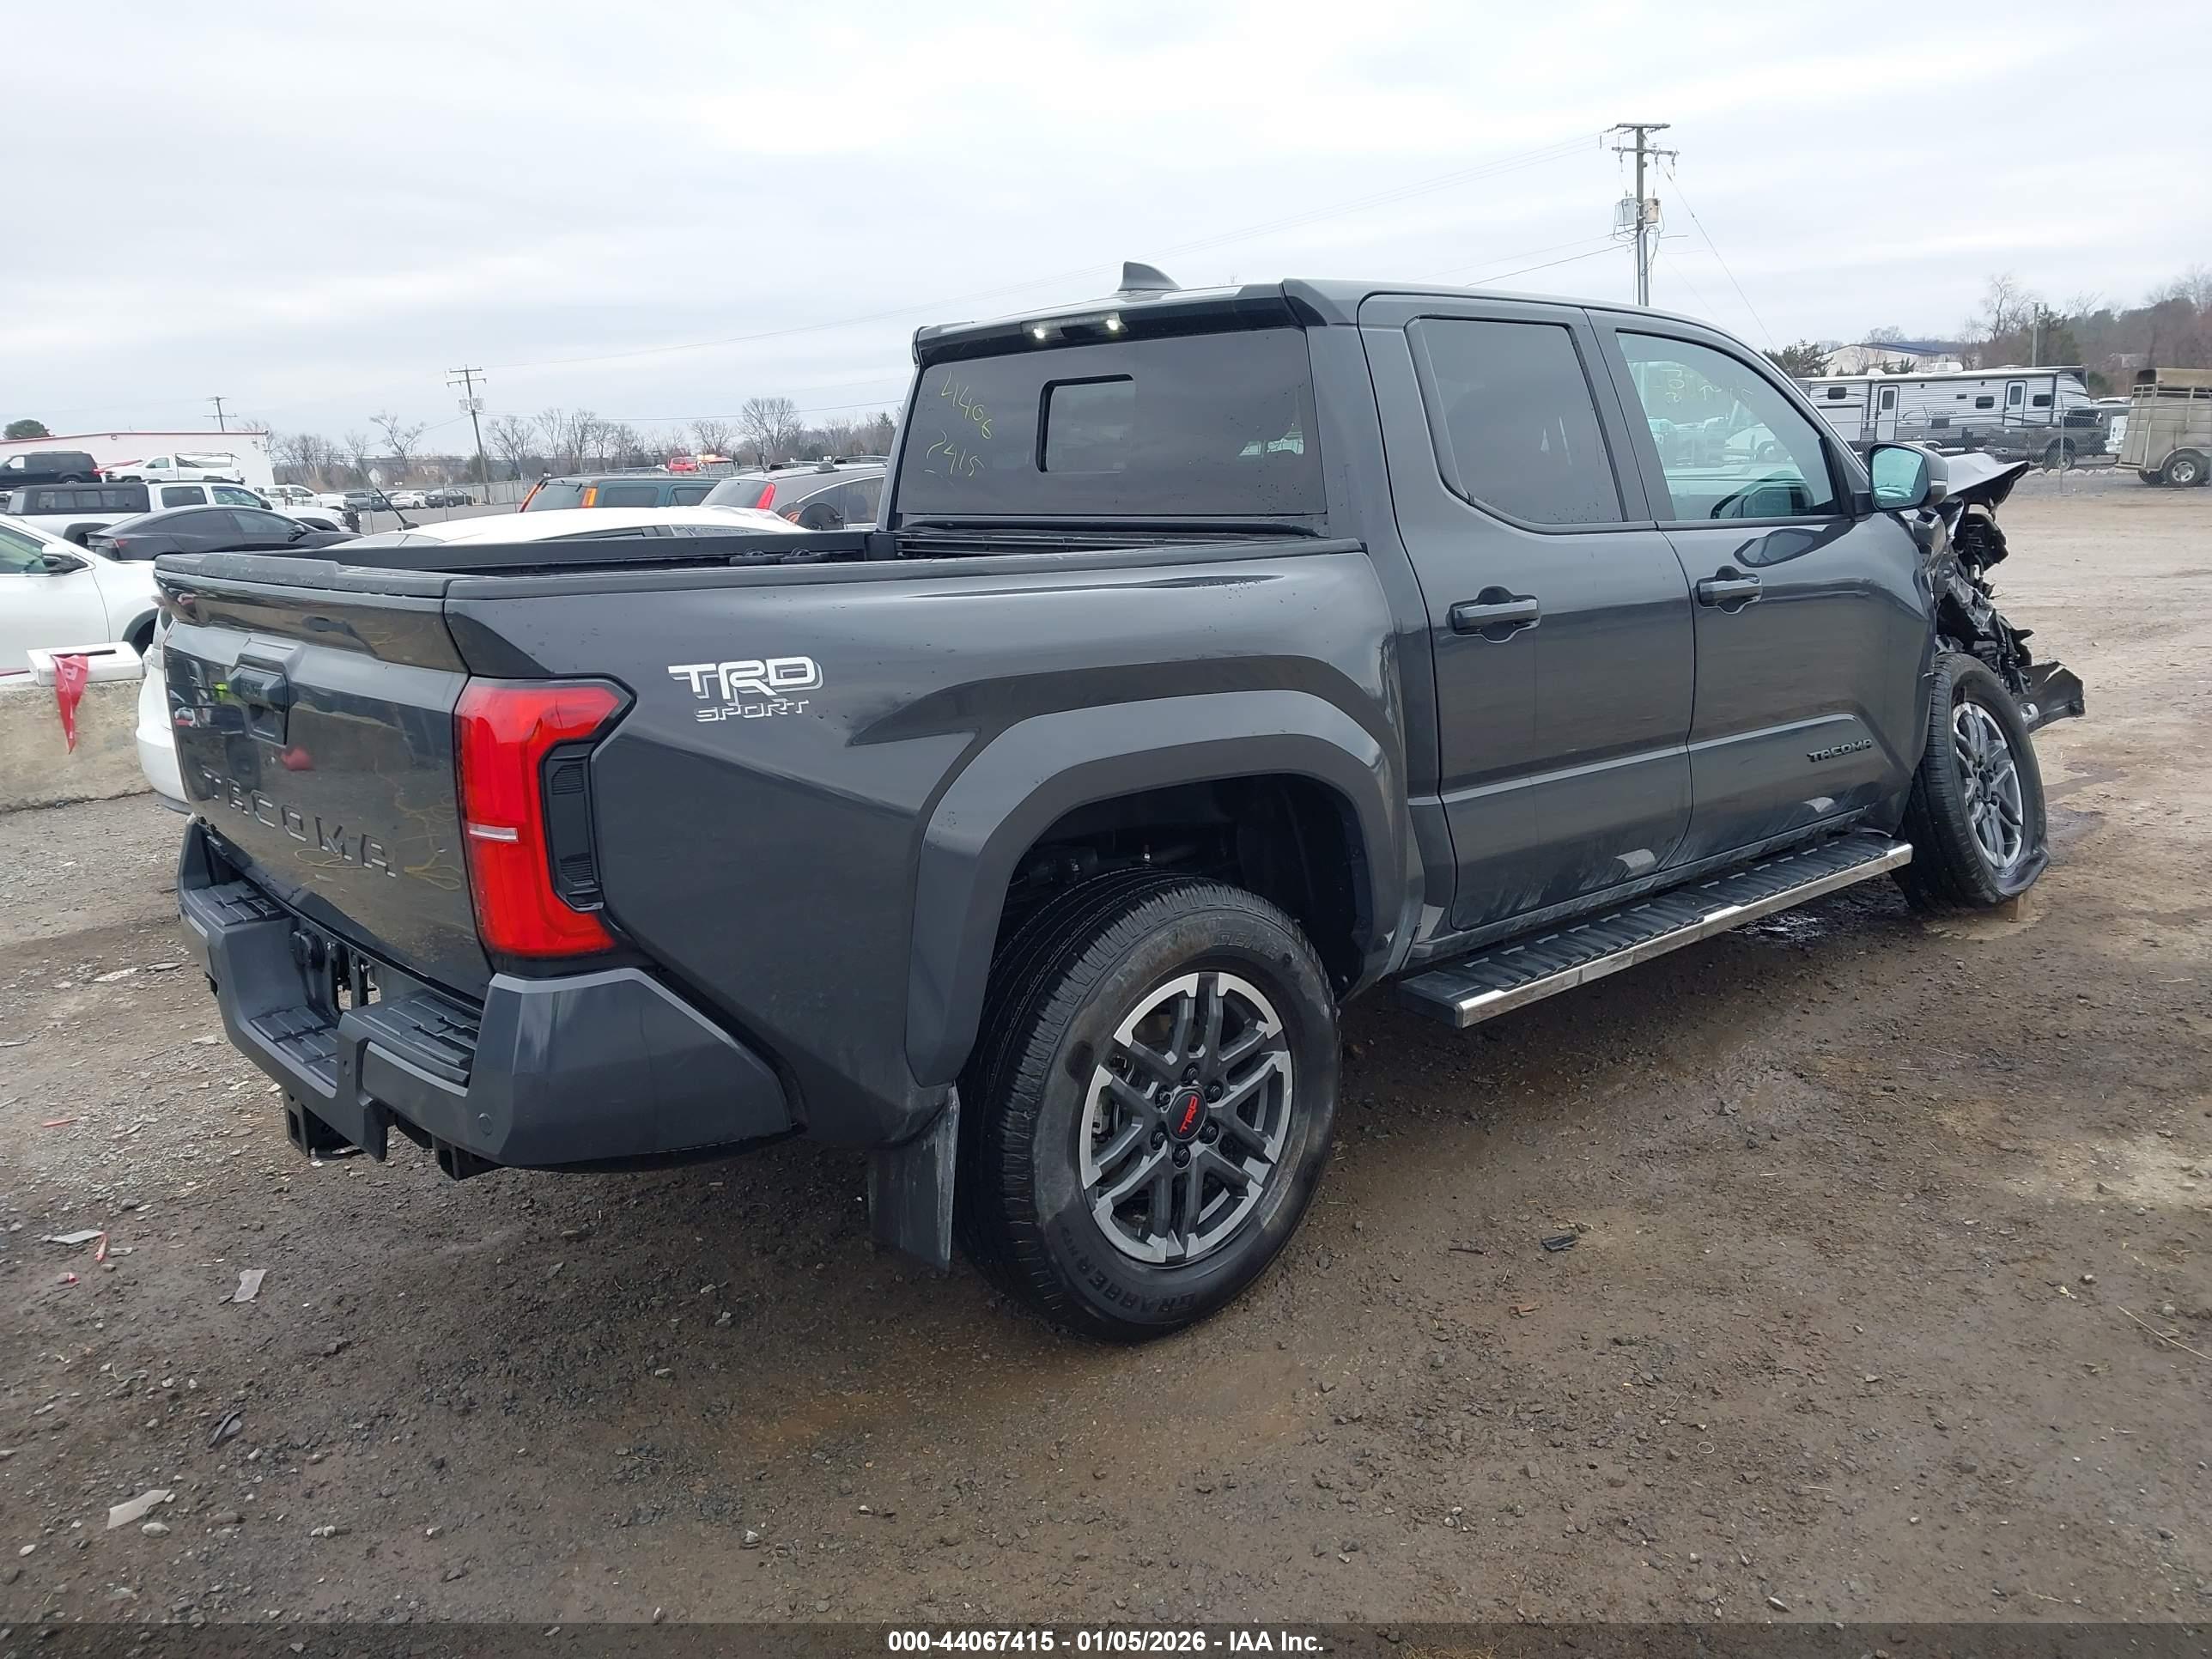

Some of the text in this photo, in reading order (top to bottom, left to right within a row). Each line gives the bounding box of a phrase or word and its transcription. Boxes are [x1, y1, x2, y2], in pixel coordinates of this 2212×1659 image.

[667, 655, 823, 705] TRD
[695, 698, 810, 722] SPORT
[1807, 738, 1872, 763] TACOMA
[198, 764, 398, 878] TACOMA
[1179, 1095, 1199, 1133] TRD
